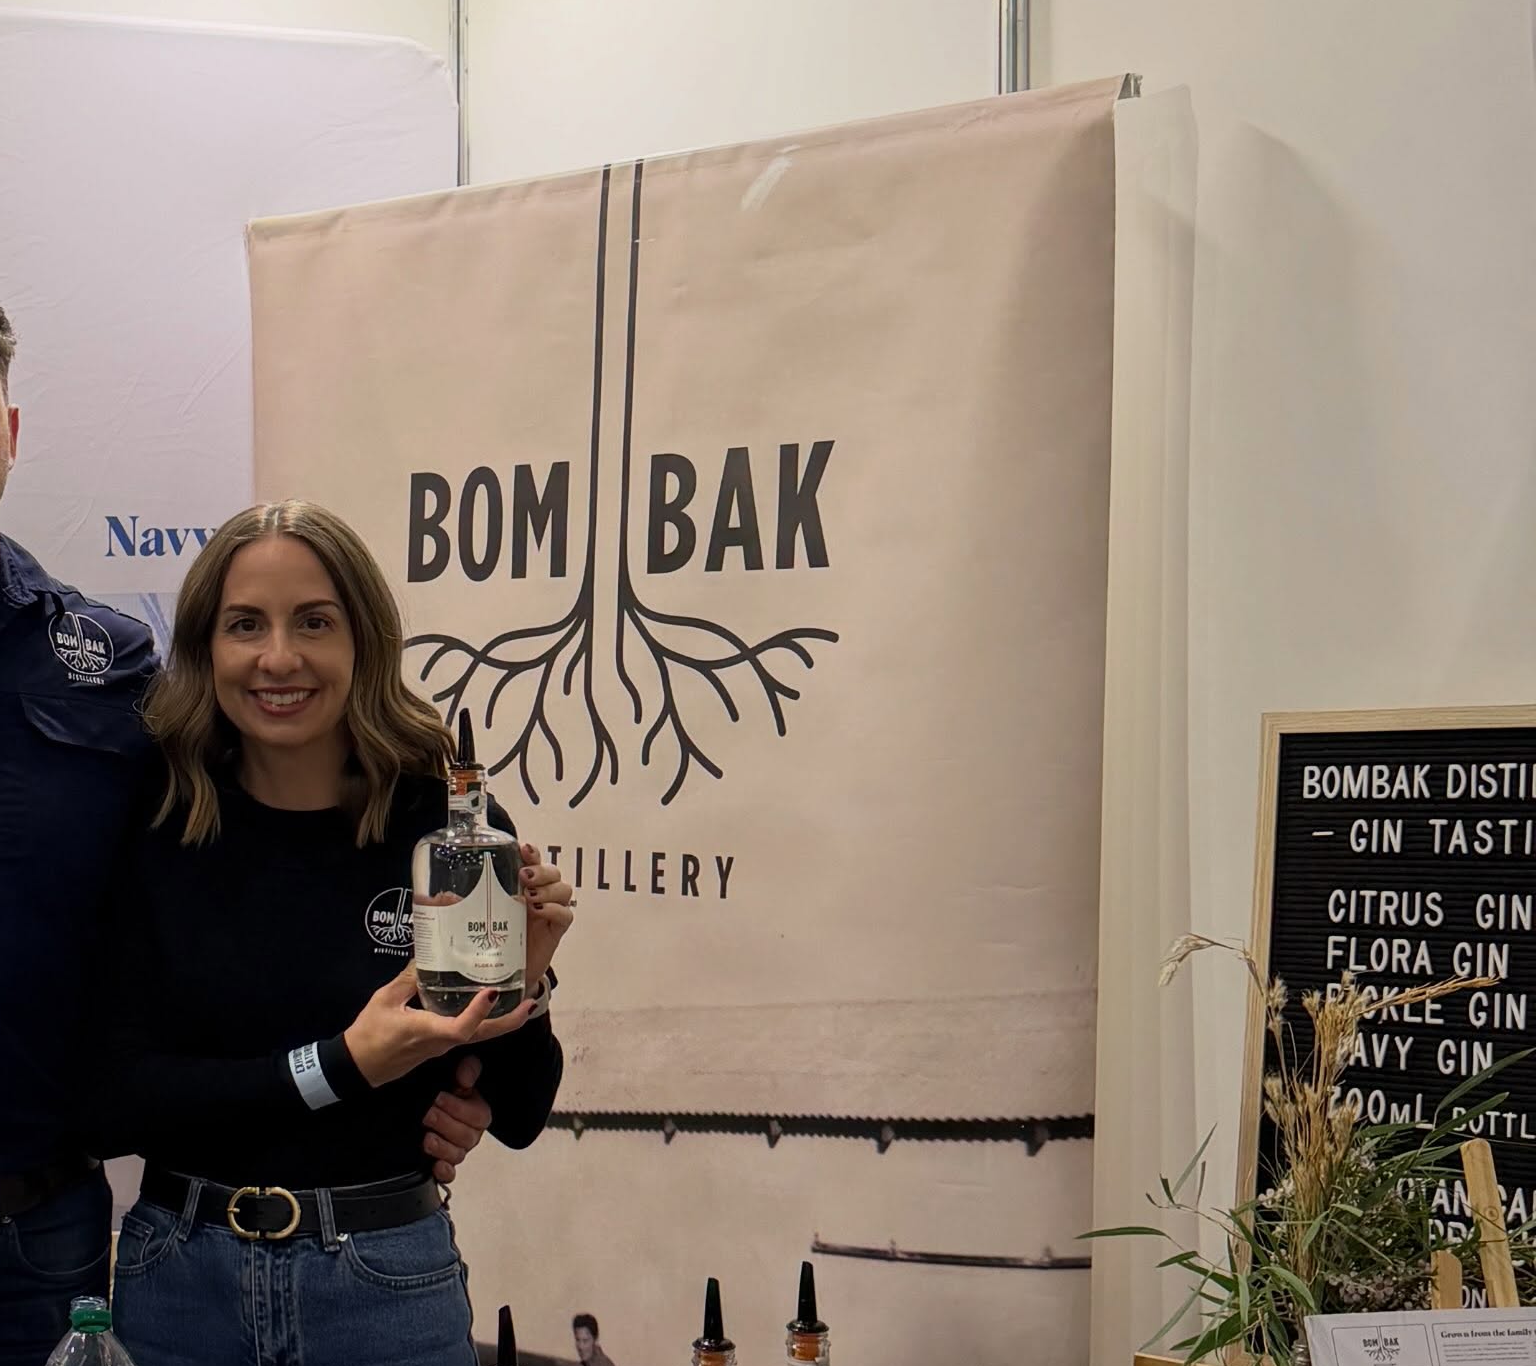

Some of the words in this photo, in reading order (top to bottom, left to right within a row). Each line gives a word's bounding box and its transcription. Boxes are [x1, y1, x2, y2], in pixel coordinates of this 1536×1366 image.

[407, 462, 570, 583] BOM
[646, 440, 836, 575] BAK
[1303, 764, 1431, 800] BOMBAK
[1350, 819, 1403, 854] GIN
[547, 846, 735, 899] TILLERY
[1328, 889, 1445, 927] CITRUS
[1476, 893, 1533, 931] GIN
[1327, 935, 1434, 976] FLORA
[1453, 942, 1510, 979] GIN
[1468, 991, 1527, 1031] GIN
[1348, 1032, 1414, 1071] AVY
[1437, 1038, 1494, 1077] GIN
